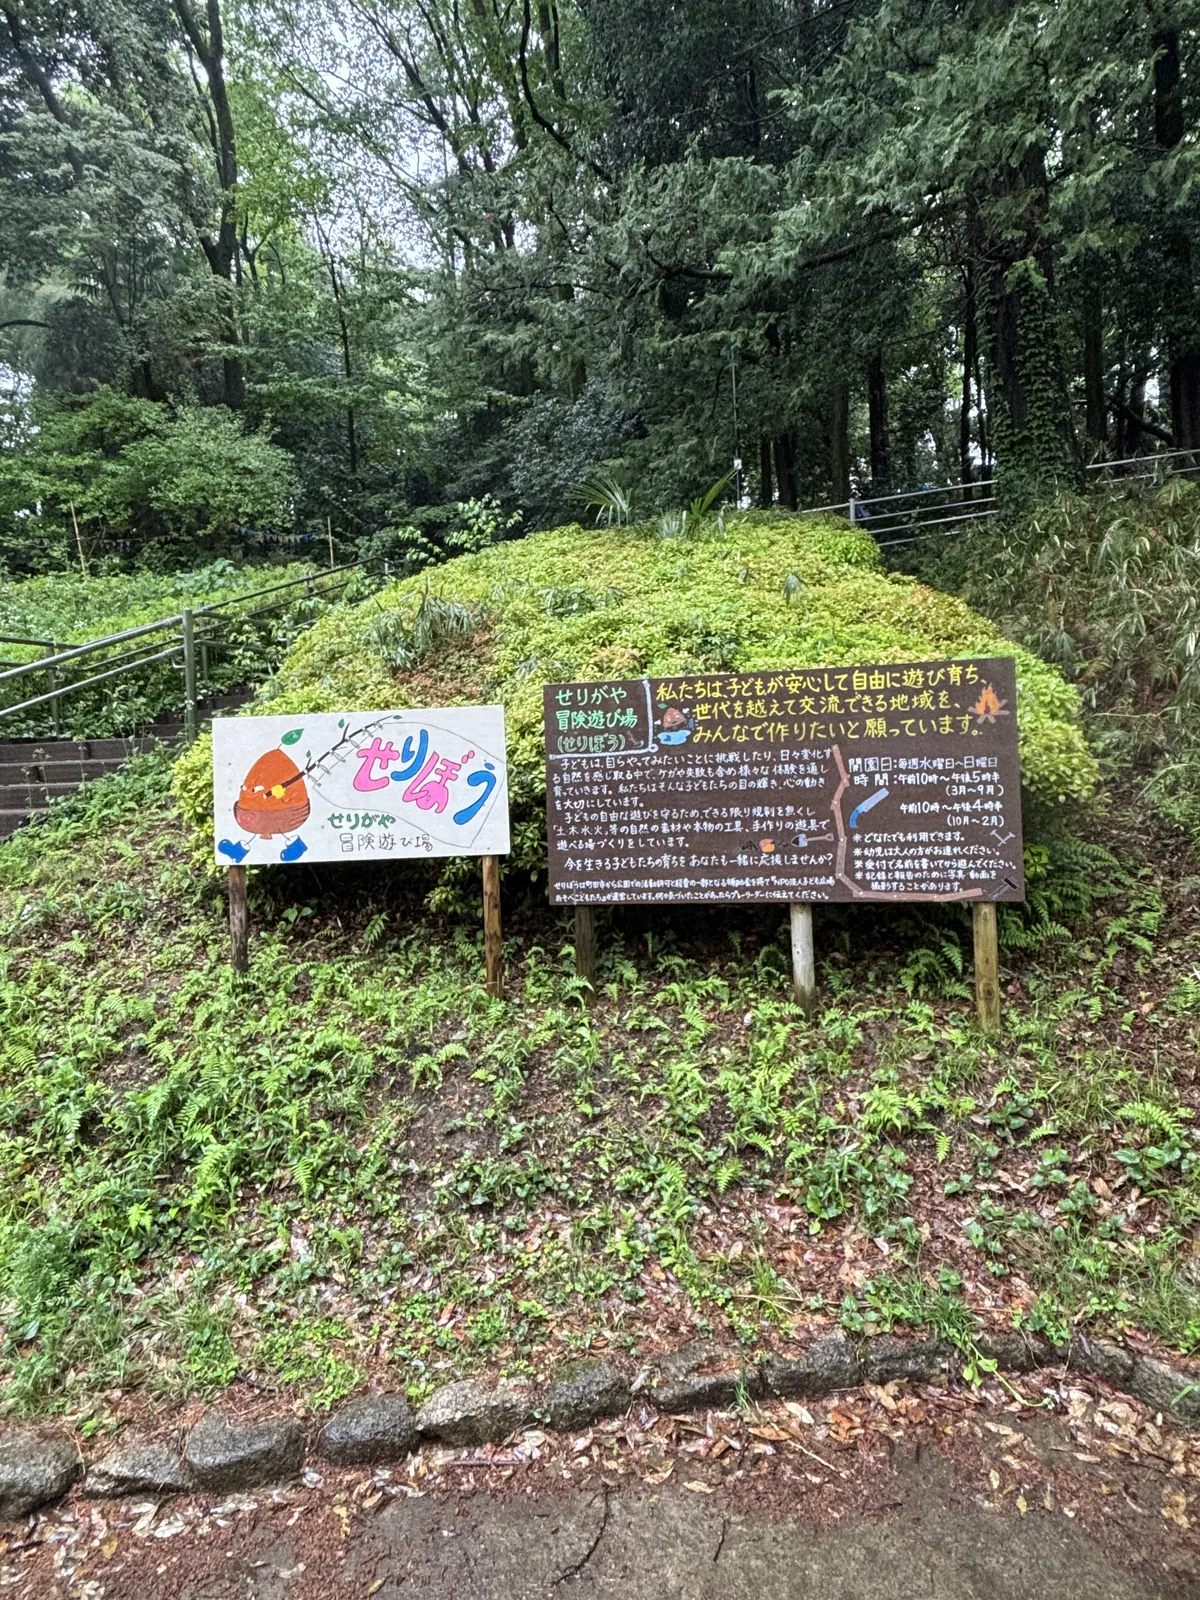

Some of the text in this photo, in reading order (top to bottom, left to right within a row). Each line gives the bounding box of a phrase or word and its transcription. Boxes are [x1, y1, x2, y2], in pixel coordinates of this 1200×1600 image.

[555, 684, 628, 706] せりがや
[692, 689, 961, 721] 世代を越えて交流できる地域を、
[555, 707, 639, 731] 冒険遊び場
[692, 714, 979, 744] みんなで作りたいと願っています。
[557, 732, 626, 753] (せりぼう)
[353, 729, 497, 826] せりぼう
[554, 795, 645, 811] を大切にしています。
[327, 812, 397, 831] せりがや
[339, 832, 434, 853] 冒険遊び場
[556, 836, 690, 851] 遊べる場づくりをしています。
